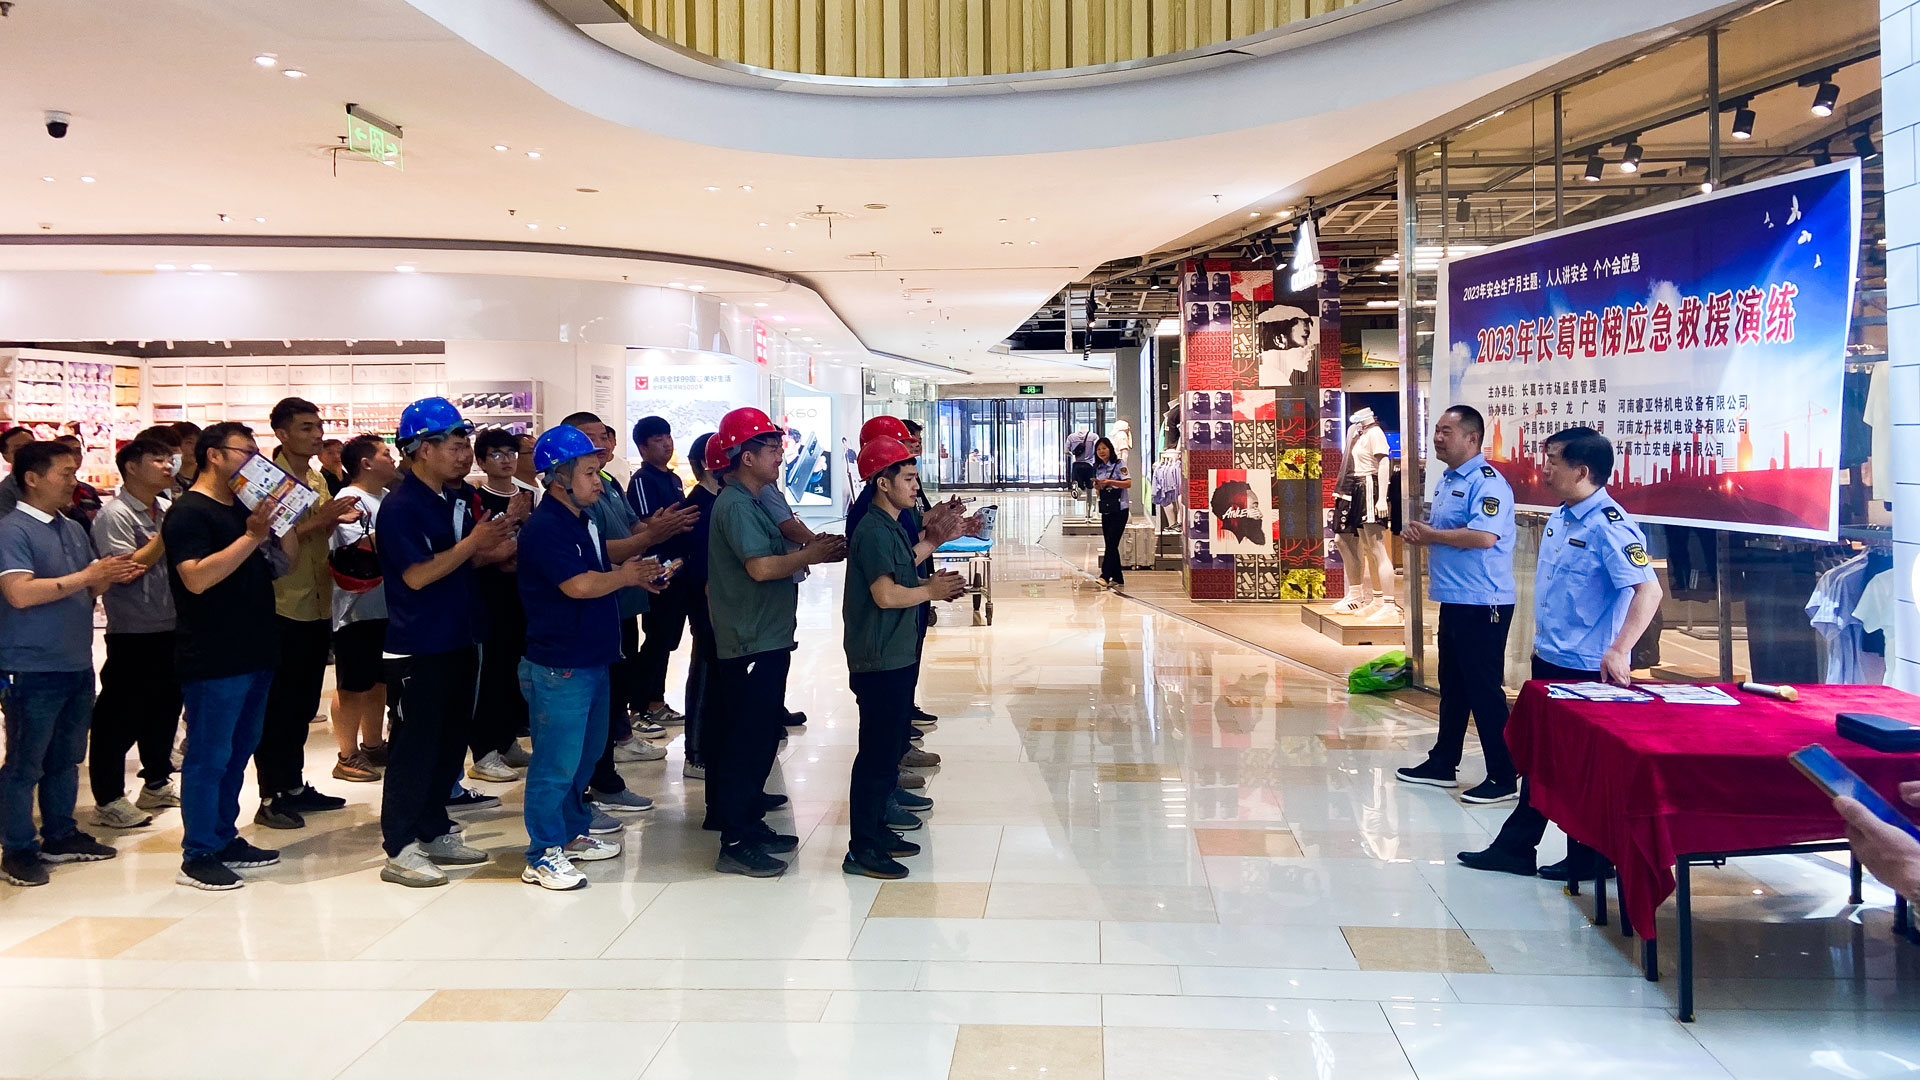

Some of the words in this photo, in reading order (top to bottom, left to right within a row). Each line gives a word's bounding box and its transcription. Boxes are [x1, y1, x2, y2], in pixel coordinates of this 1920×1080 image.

[1593, 252, 1641, 279] 个个会应急
[1475, 281, 1799, 364] 2023年长葛电梯应急救援演练
[1617, 394, 1748, 413] 河南睿亚特机电设备有限公司
[1617, 417, 1748, 435] 河南龙升祥机电设备有限公司
[1615, 440, 1724, 457] 长葛市立宏电梯有限公司
